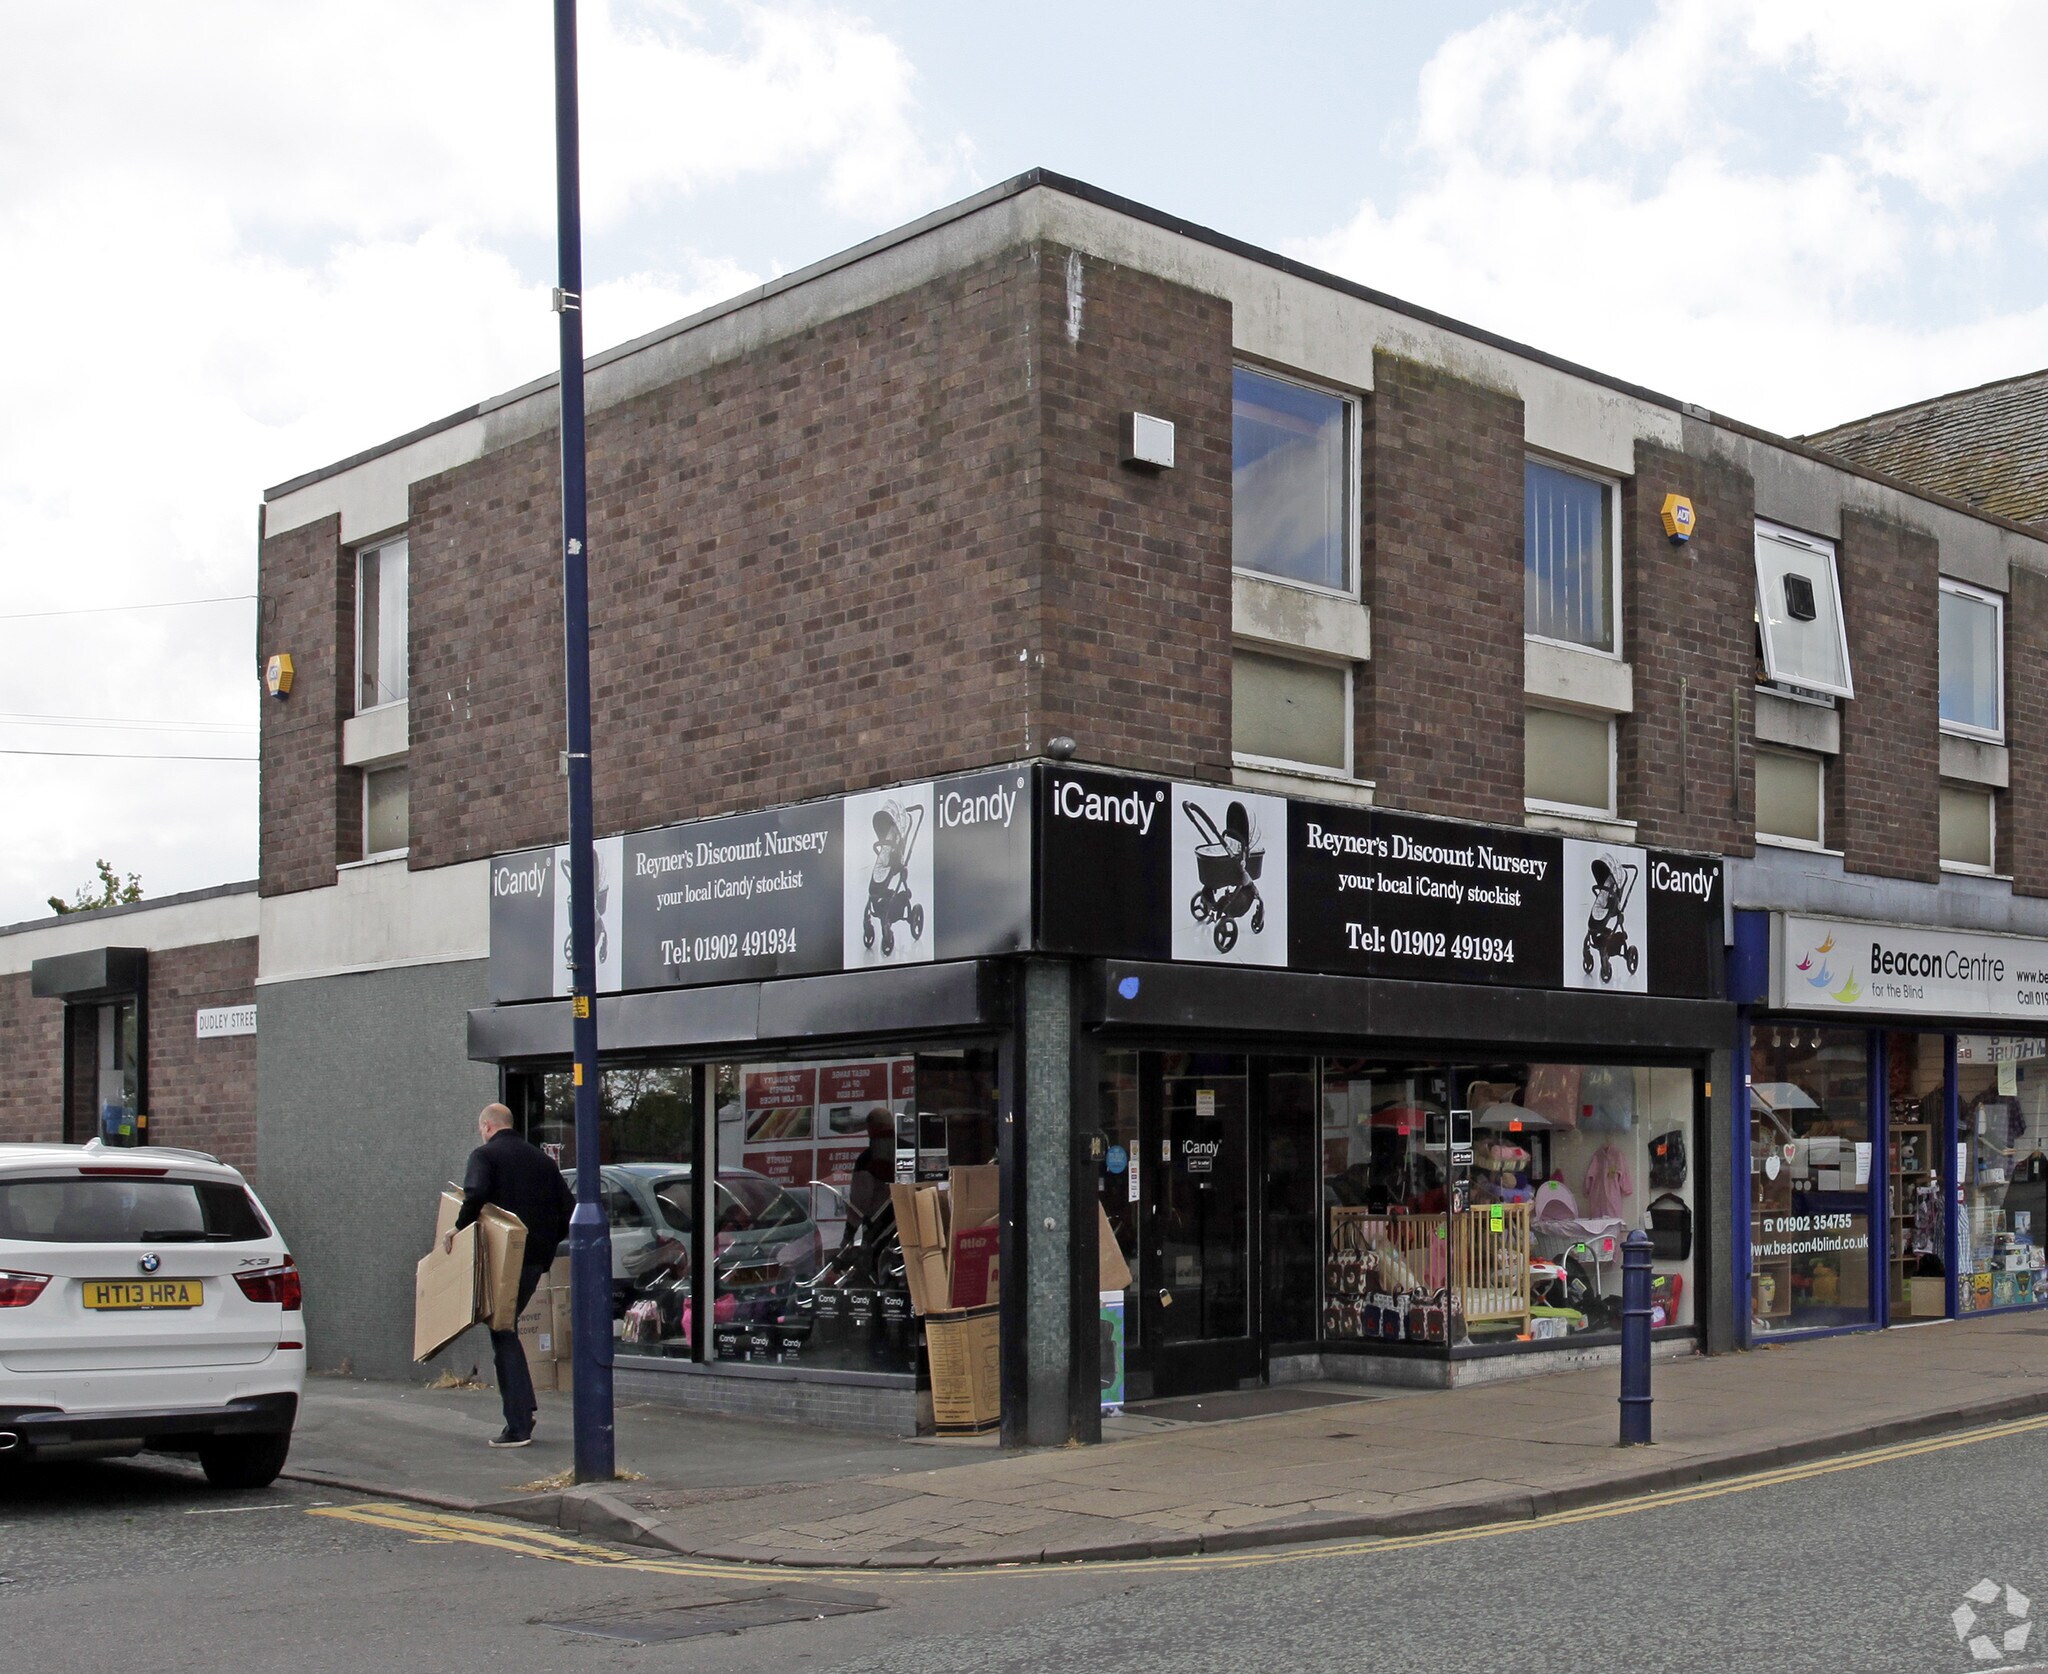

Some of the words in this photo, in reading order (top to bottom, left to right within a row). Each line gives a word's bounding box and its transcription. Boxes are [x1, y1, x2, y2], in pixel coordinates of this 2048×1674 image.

[635, 850, 693, 879] Reyner's
[696, 836, 762, 867] Discount
[764, 831, 828, 857] Nursery
[1307, 823, 1388, 856] Reyner's
[1392, 834, 1474, 868] Discount
[1477, 846, 1547, 880] Nursery
[657, 889, 684, 911] your
[685, 881, 711, 903] local
[756, 869, 803, 894] stockist
[1338, 873, 1375, 891] your
[1377, 873, 1412, 895] local
[1415, 876, 1464, 904] iCandy
[1468, 885, 1521, 906] stockist
[661, 938, 691, 965] Tel:
[694, 933, 738, 962] 01902
[741, 927, 797, 956] 491934
[1345, 923, 1386, 952] Tel:
[1390, 929, 1446, 957] 01902
[1450, 935, 1515, 963] 491934
[1872, 983, 1884, 997] for
[1886, 983, 1901, 998] the
[1903, 984, 1924, 999] Blind
[2017, 990, 2034, 1005] Call
[199, 1013, 228, 1030] DUDLEY
[1182, 1140, 1220, 1157] iCandy
[1776, 1216, 1811, 1233] 01902
[1813, 1213, 1852, 1230] 354755
[238, 1257, 271, 1267] X3
[97, 1285, 144, 1304] HT13
[151, 1284, 190, 1303] HRA
